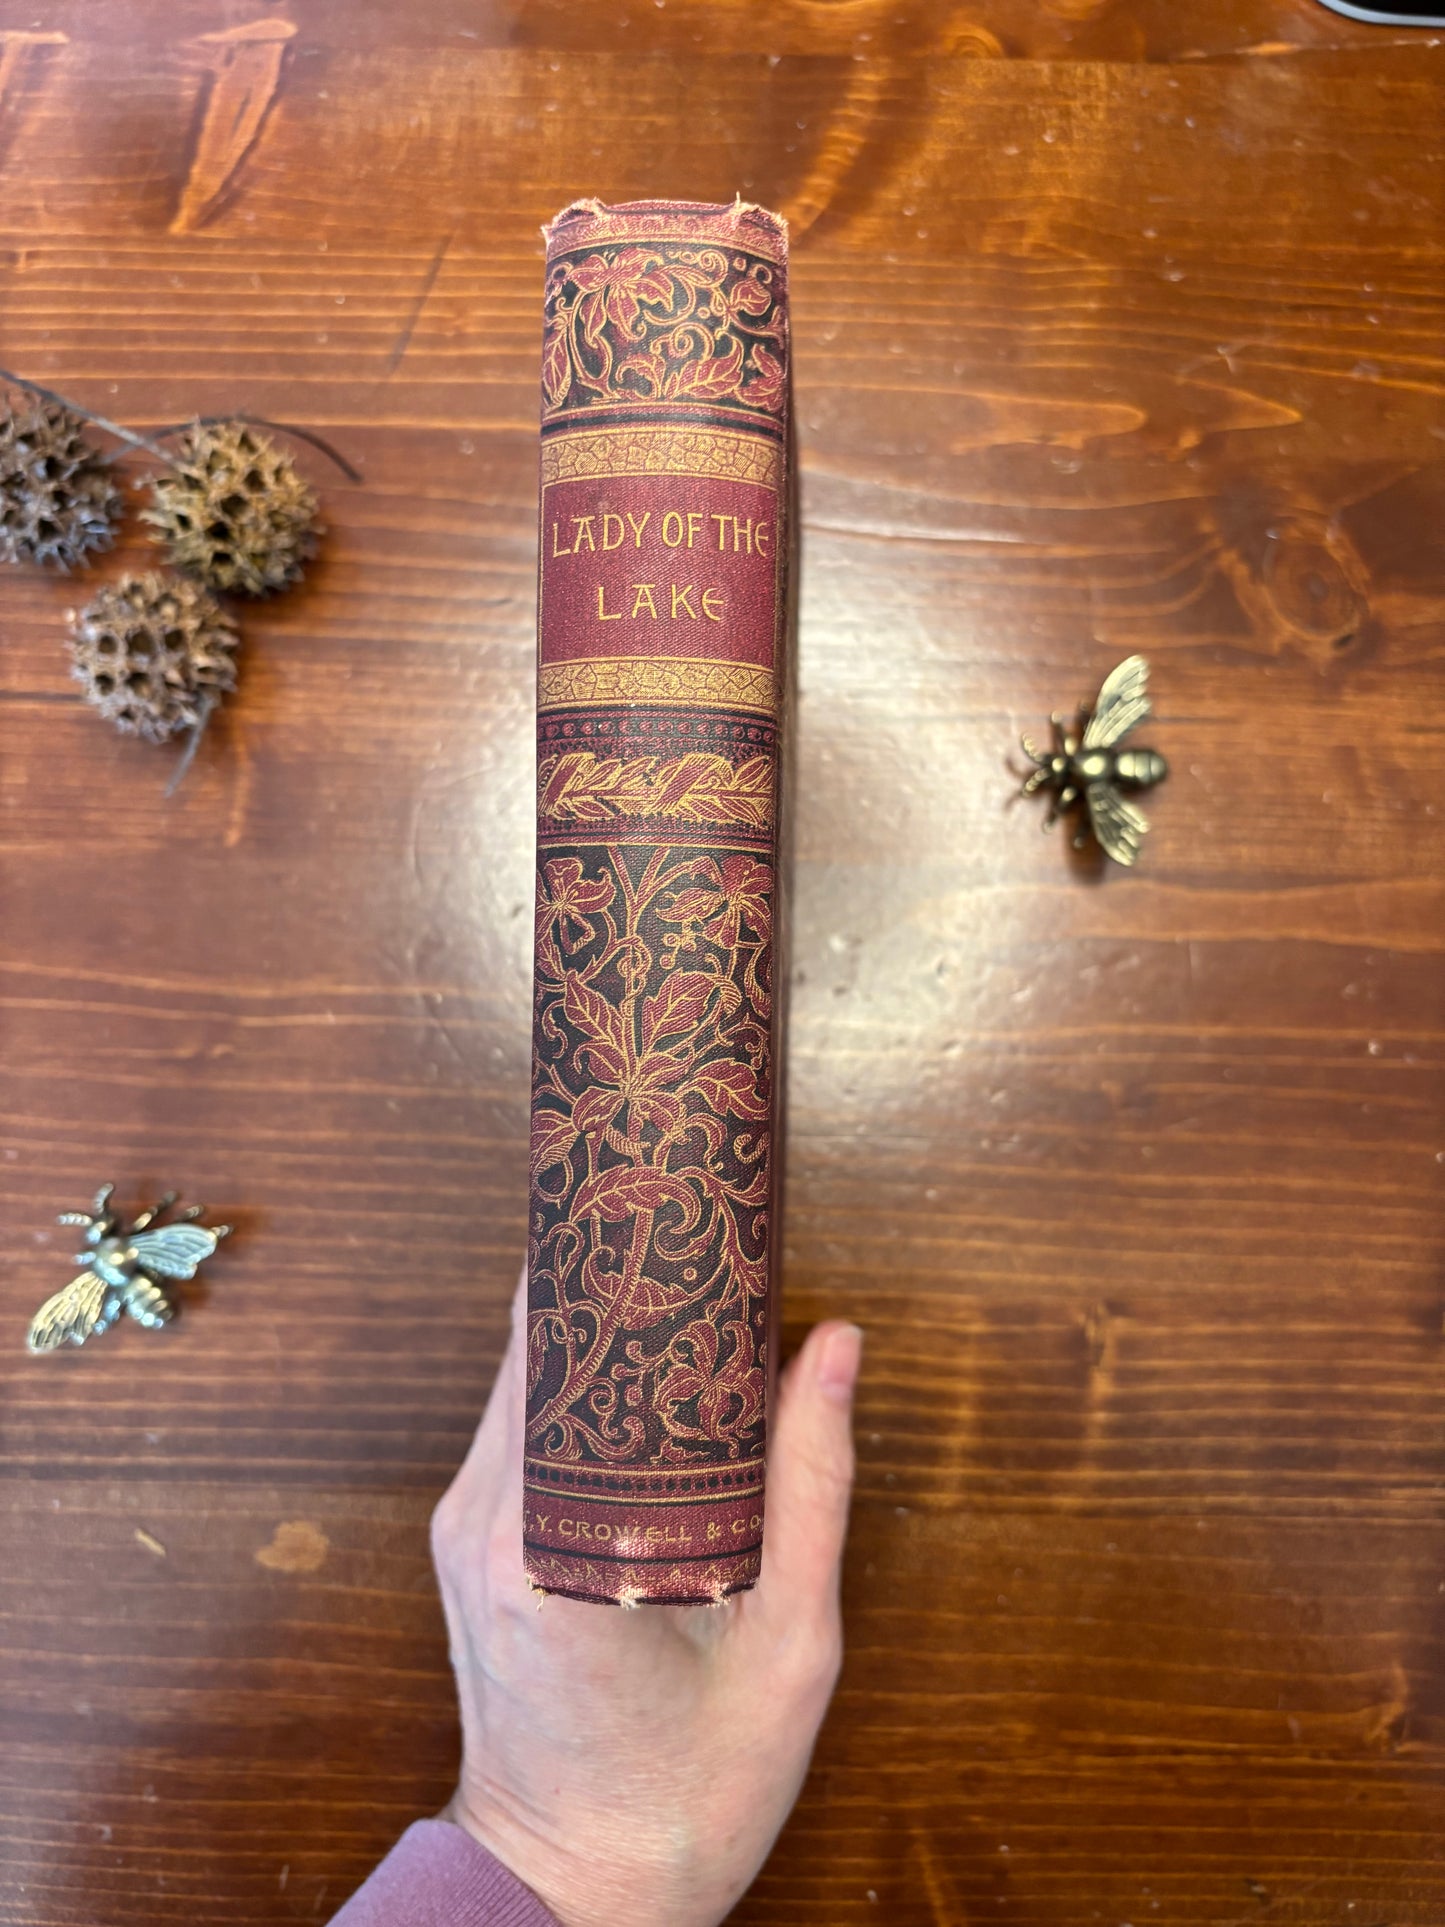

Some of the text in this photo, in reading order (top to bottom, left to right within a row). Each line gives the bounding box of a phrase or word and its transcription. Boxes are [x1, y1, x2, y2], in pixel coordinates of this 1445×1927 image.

[553, 511, 769, 557] LADY OF THE
[598, 584, 725, 621] LAKE
[558, 1518, 692, 1544] CROWELL
[706, 1521, 721, 1541] &
